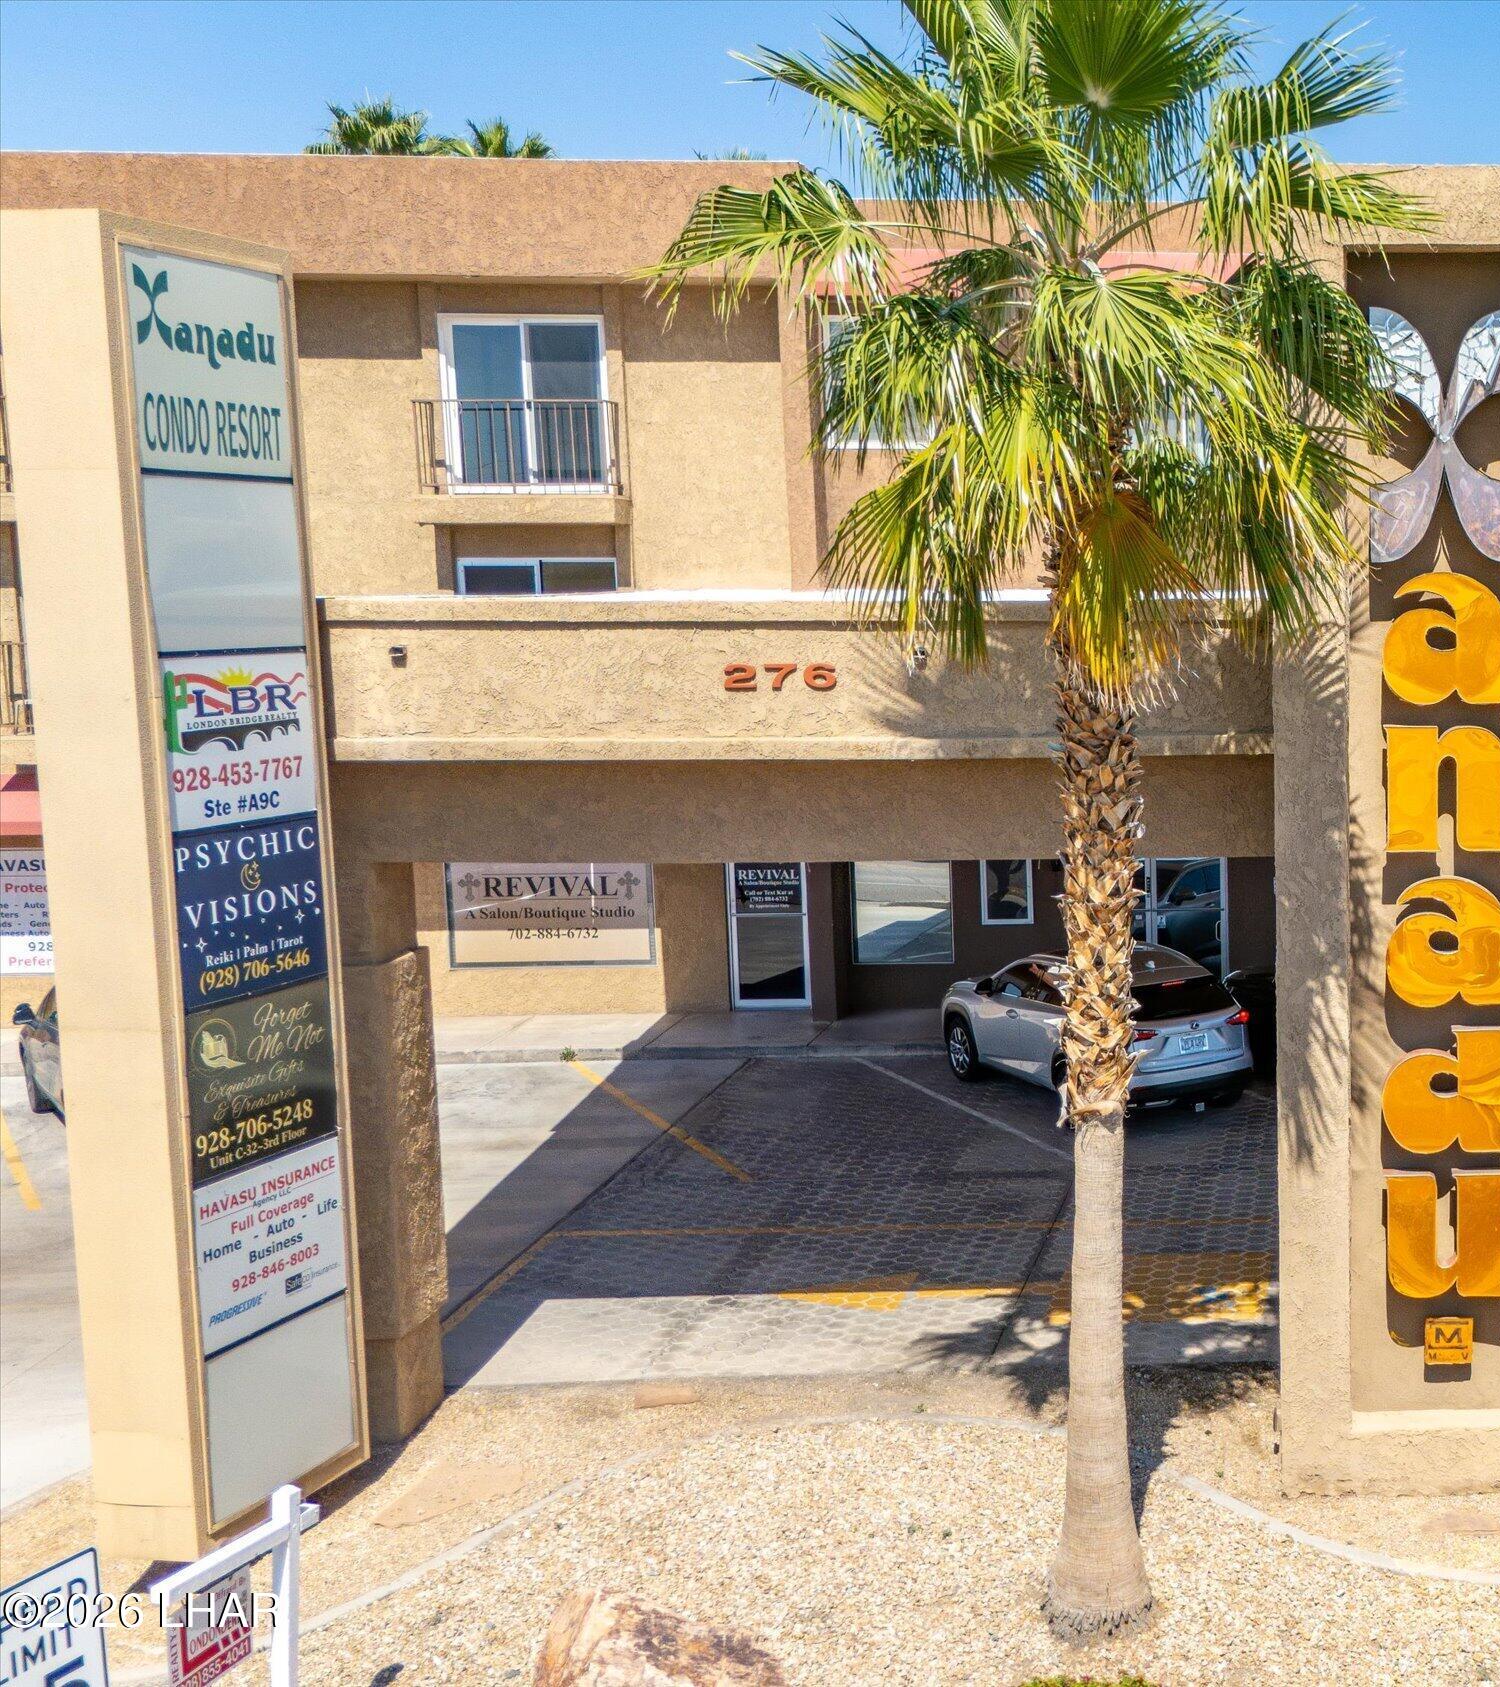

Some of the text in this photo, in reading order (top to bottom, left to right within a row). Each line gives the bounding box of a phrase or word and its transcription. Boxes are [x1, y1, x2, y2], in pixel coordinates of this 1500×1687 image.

[132, 263, 276, 370] Xanadu
[144, 392, 281, 461] CONDO RESORT
[724, 663, 838, 691] 276
[192, 684, 297, 718] LBR
[187, 712, 298, 730] LONDON BRIDGE REALTY
[172, 756, 303, 793] 928-453-7767
[204, 791, 280, 818] Ste #A9C
[175, 826, 315, 872] PSYCHIC
[483, 874, 618, 898] REVIVAL
[738, 869, 799, 880] REVIVAL
[185, 880, 317, 929] VISIONS
[464, 906, 635, 921] A Salon/Boutique Studio
[507, 927, 599, 941] 702-884-6732
[205, 951, 234, 968] Reiki
[243, 945, 268, 958] Palm
[277, 936, 304, 949] Tarot
[200, 948, 310, 995] (928) 706-5646
[253, 1001, 312, 1033] Forget
[247, 1023, 326, 1063] Me Not
[195, 1099, 314, 1157] 928-706-5248
[209, 1152, 234, 1169] Unit
[281, 1126, 308, 1142] Floor
[200, 1155, 336, 1220] HAVASU INSURANCE
[252, 1187, 292, 1209] Agency LLC
[231, 1191, 315, 1234] Full Coverage
[203, 1239, 242, 1263] Home
[266, 1216, 295, 1237] Auto
[317, 1198, 338, 1216] Life
[248, 1232, 304, 1264] Business
[231, 1243, 320, 1292] 928-846-8003
[208, 1294, 263, 1328] PROGRESSIVE
[1435, 1327, 1462, 1343] M
[0, 1621, 72, 1686] IMIT
